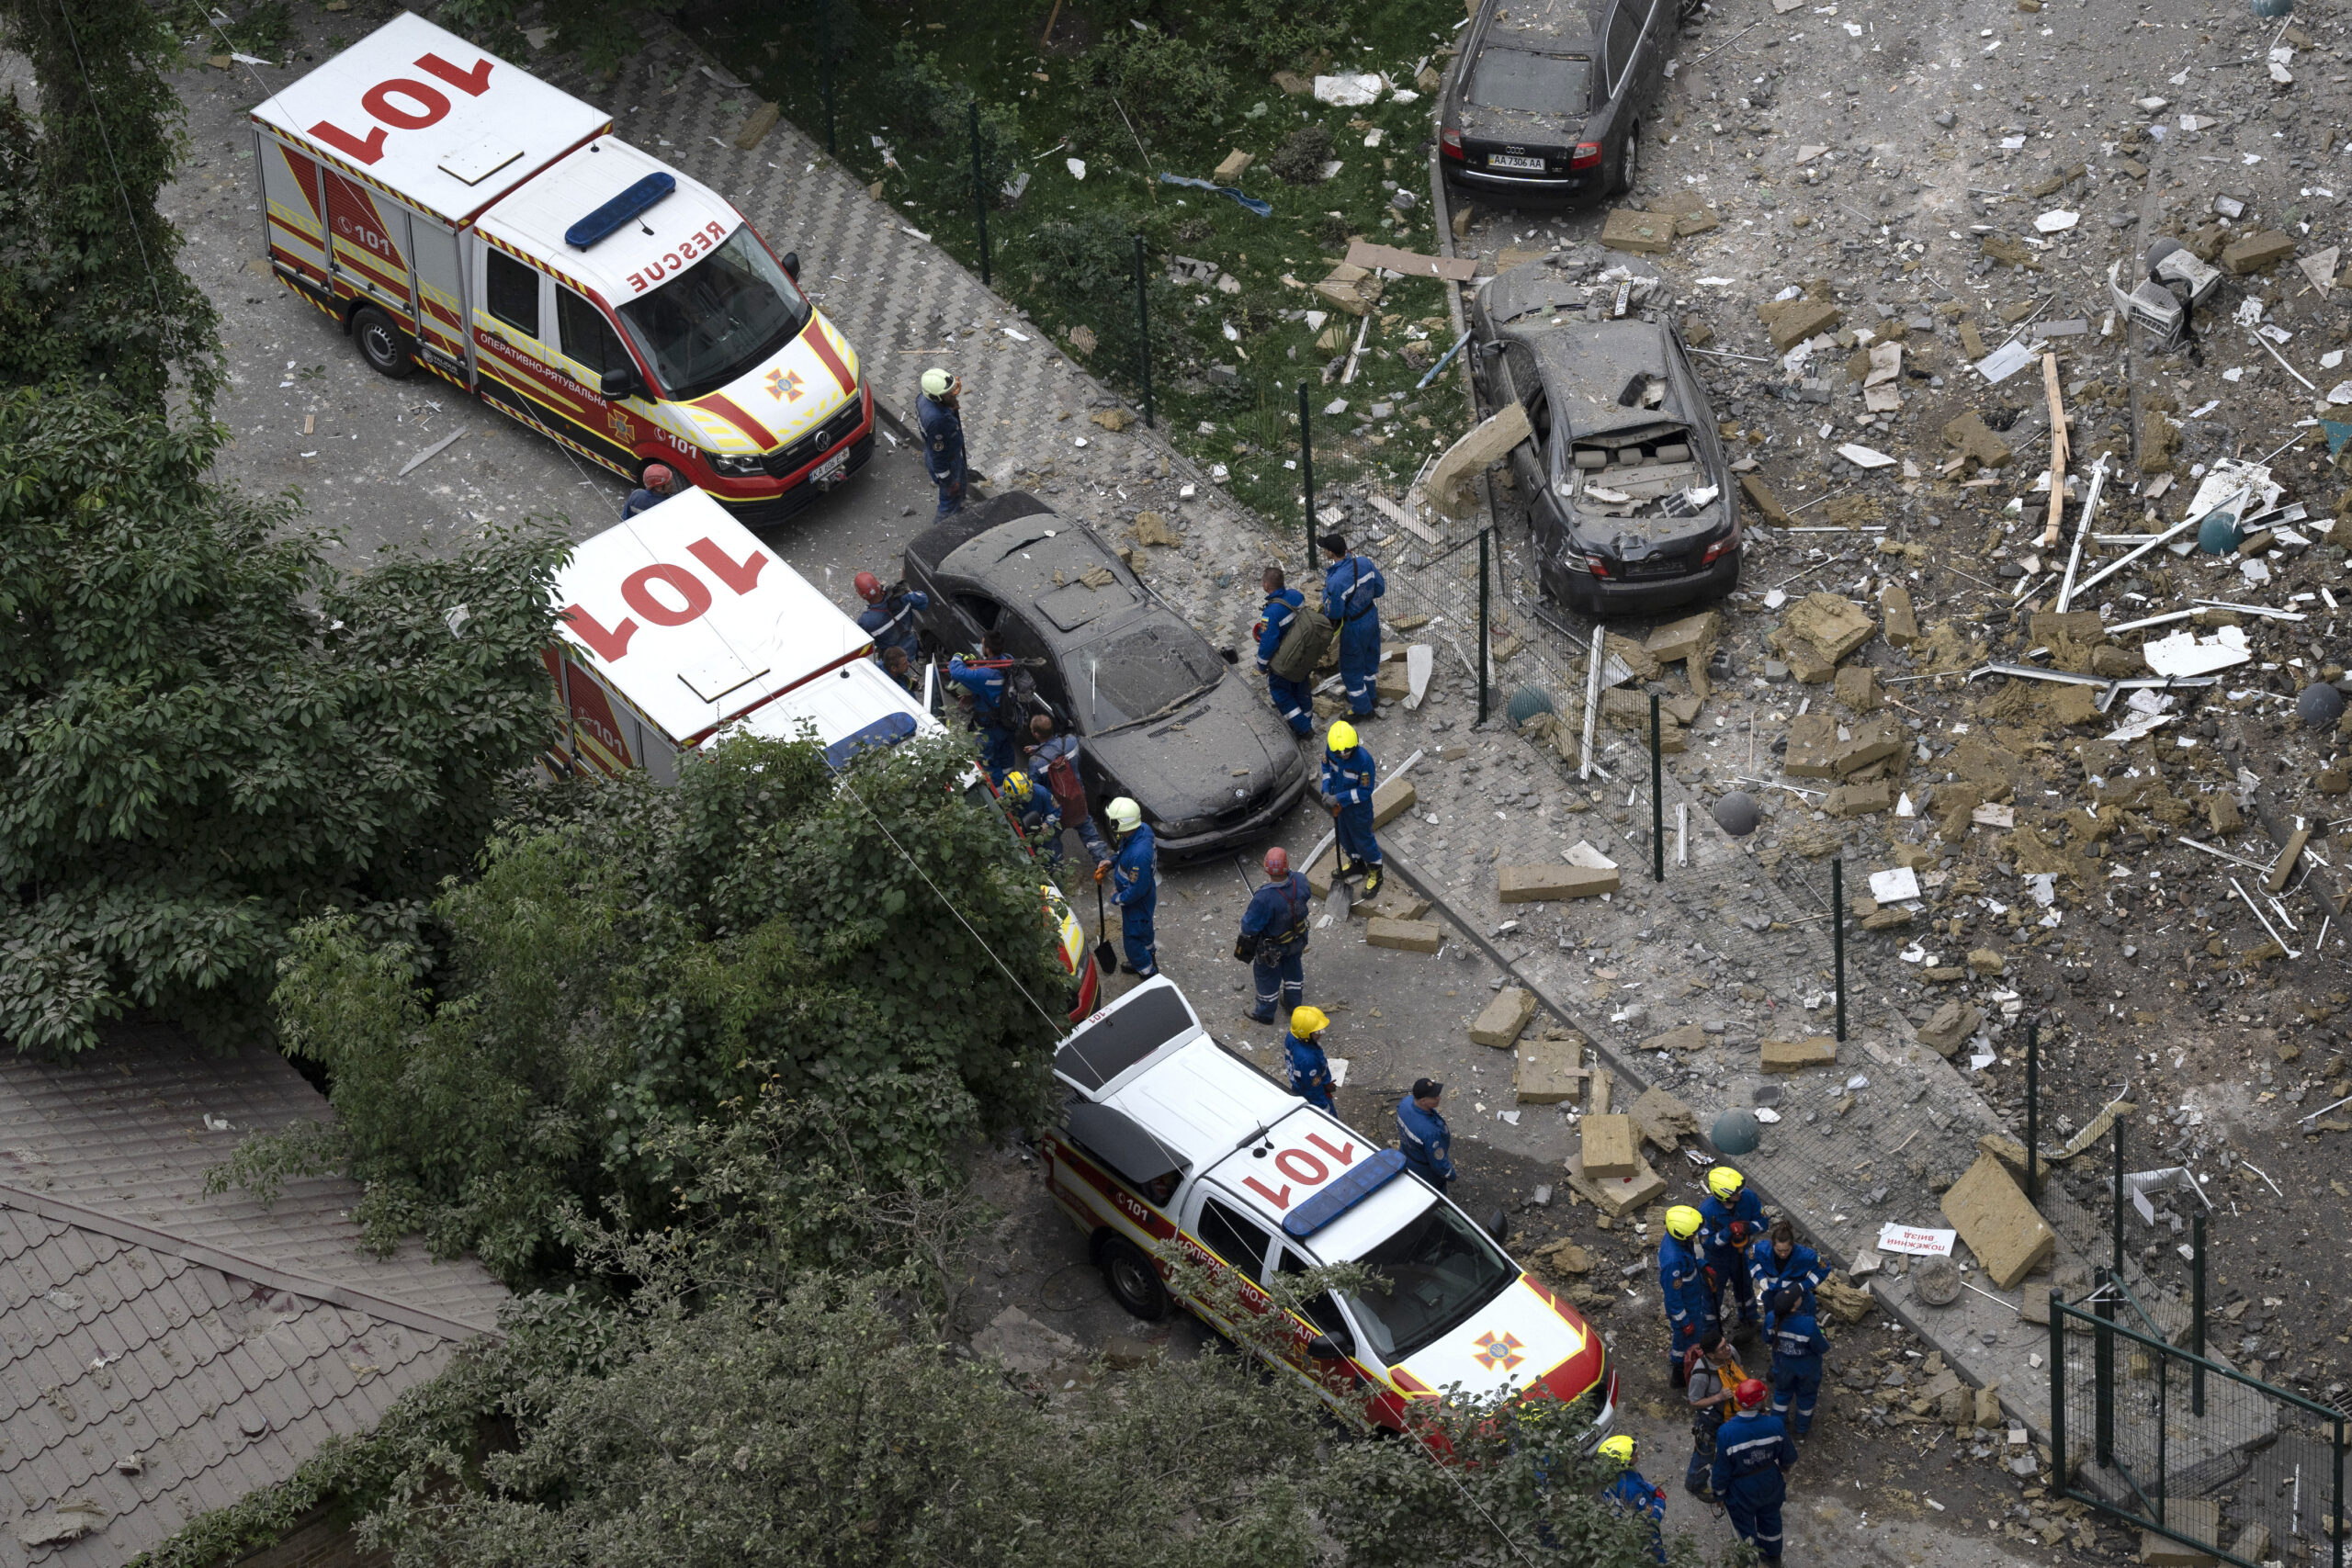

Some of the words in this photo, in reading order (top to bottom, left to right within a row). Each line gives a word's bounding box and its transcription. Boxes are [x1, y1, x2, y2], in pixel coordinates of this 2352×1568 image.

[307, 53, 493, 164] 101
[1494, 155, 1507, 166] AA
[1508, 156, 1527, 167] 7306
[1529, 158, 1542, 168] AA
[355, 225, 390, 255] 101
[480, 333, 607, 409] ОПЕРАТИВНО-РЯТУВАЛЬНА
[668, 434, 697, 459] 101
[560, 537, 769, 663] 101
[591, 720, 623, 757] 101
[1088, 1011, 1106, 1024] 101
[1243, 1134, 1353, 1211] 101
[1126, 1199, 1148, 1222] 101
[1886, 1237, 1945, 1251] ПОЖЕЖНИЙ
[1904, 1232, 1935, 1242] ВИЇЗД
